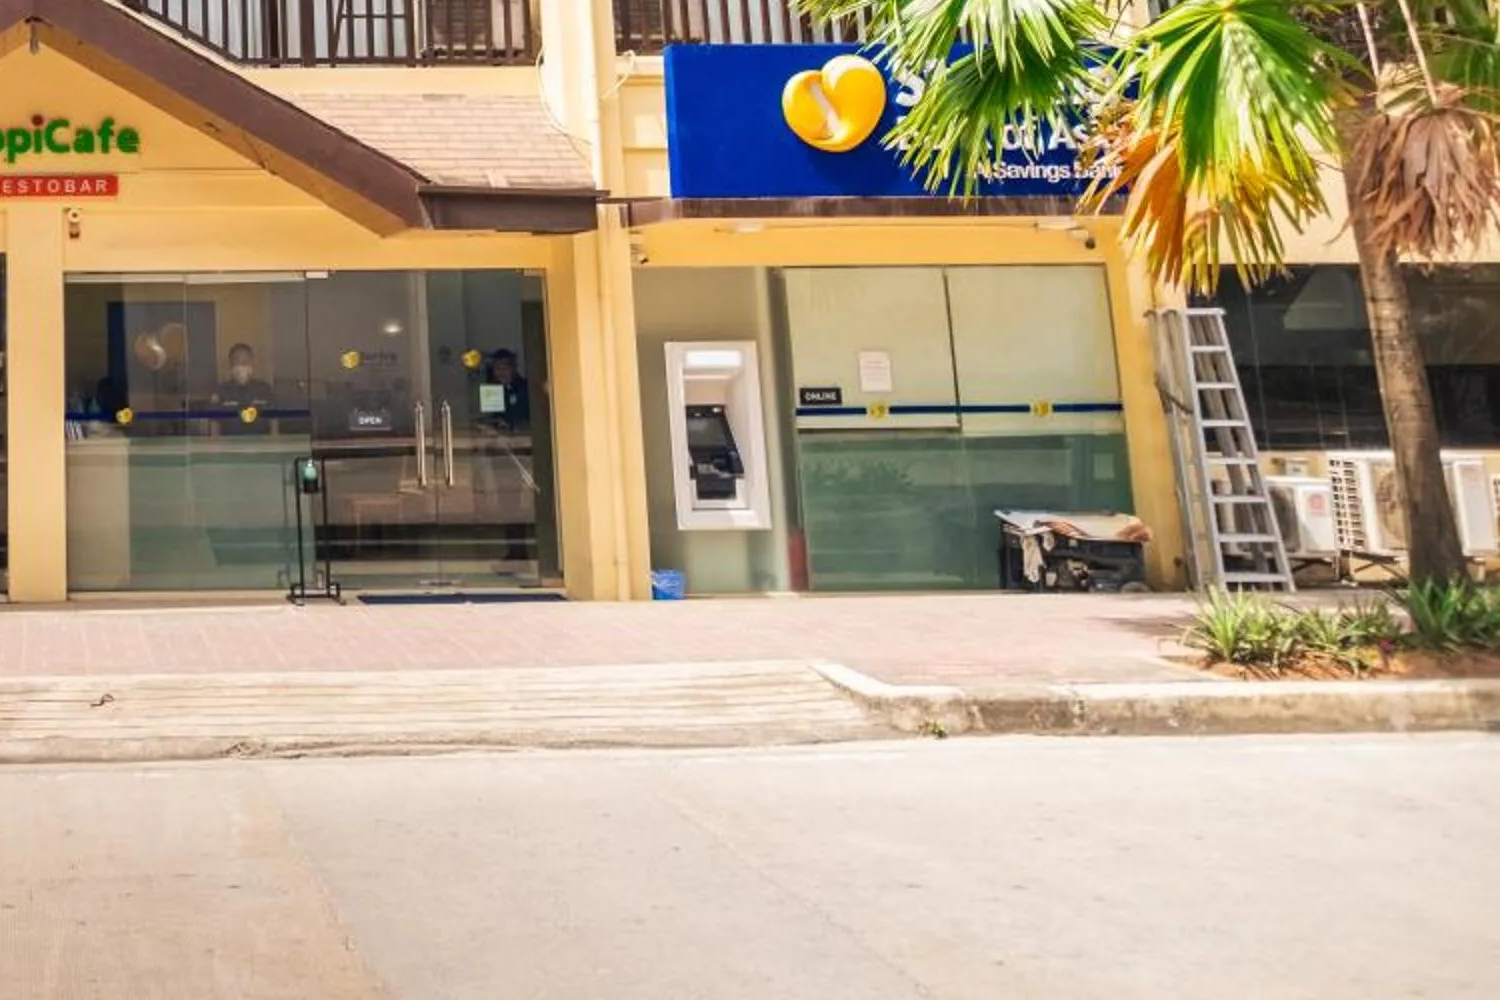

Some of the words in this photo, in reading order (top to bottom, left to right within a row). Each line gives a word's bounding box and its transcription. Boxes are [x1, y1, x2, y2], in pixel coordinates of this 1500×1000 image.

[993, 161, 1071, 183] Savings
[804, 391, 837, 401] ONLINE
[358, 416, 382, 425] OPEN
